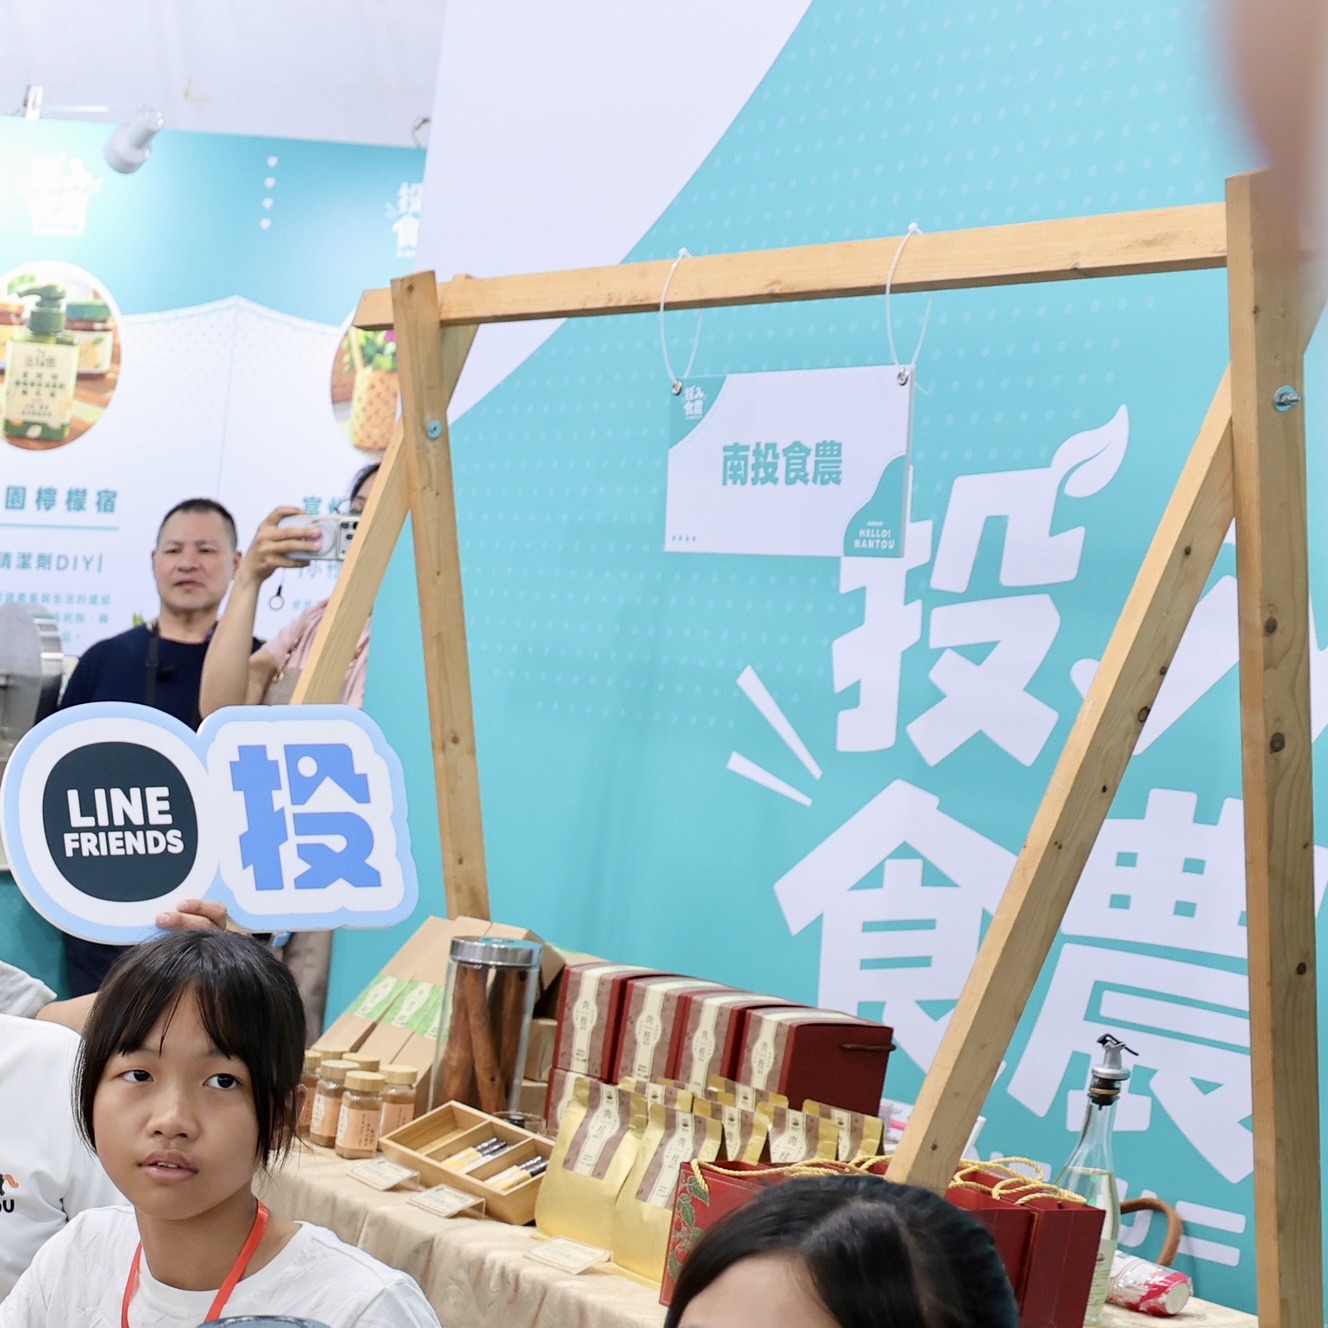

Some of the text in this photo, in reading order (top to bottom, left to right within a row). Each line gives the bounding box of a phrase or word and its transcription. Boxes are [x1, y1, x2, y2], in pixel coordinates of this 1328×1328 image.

[722, 440, 843, 487] 南投食農
[853, 538, 895, 550] NANTOU
[66, 786, 174, 828] LINE
[229, 743, 383, 891] 投
[63, 829, 185, 858] FRIENDS
